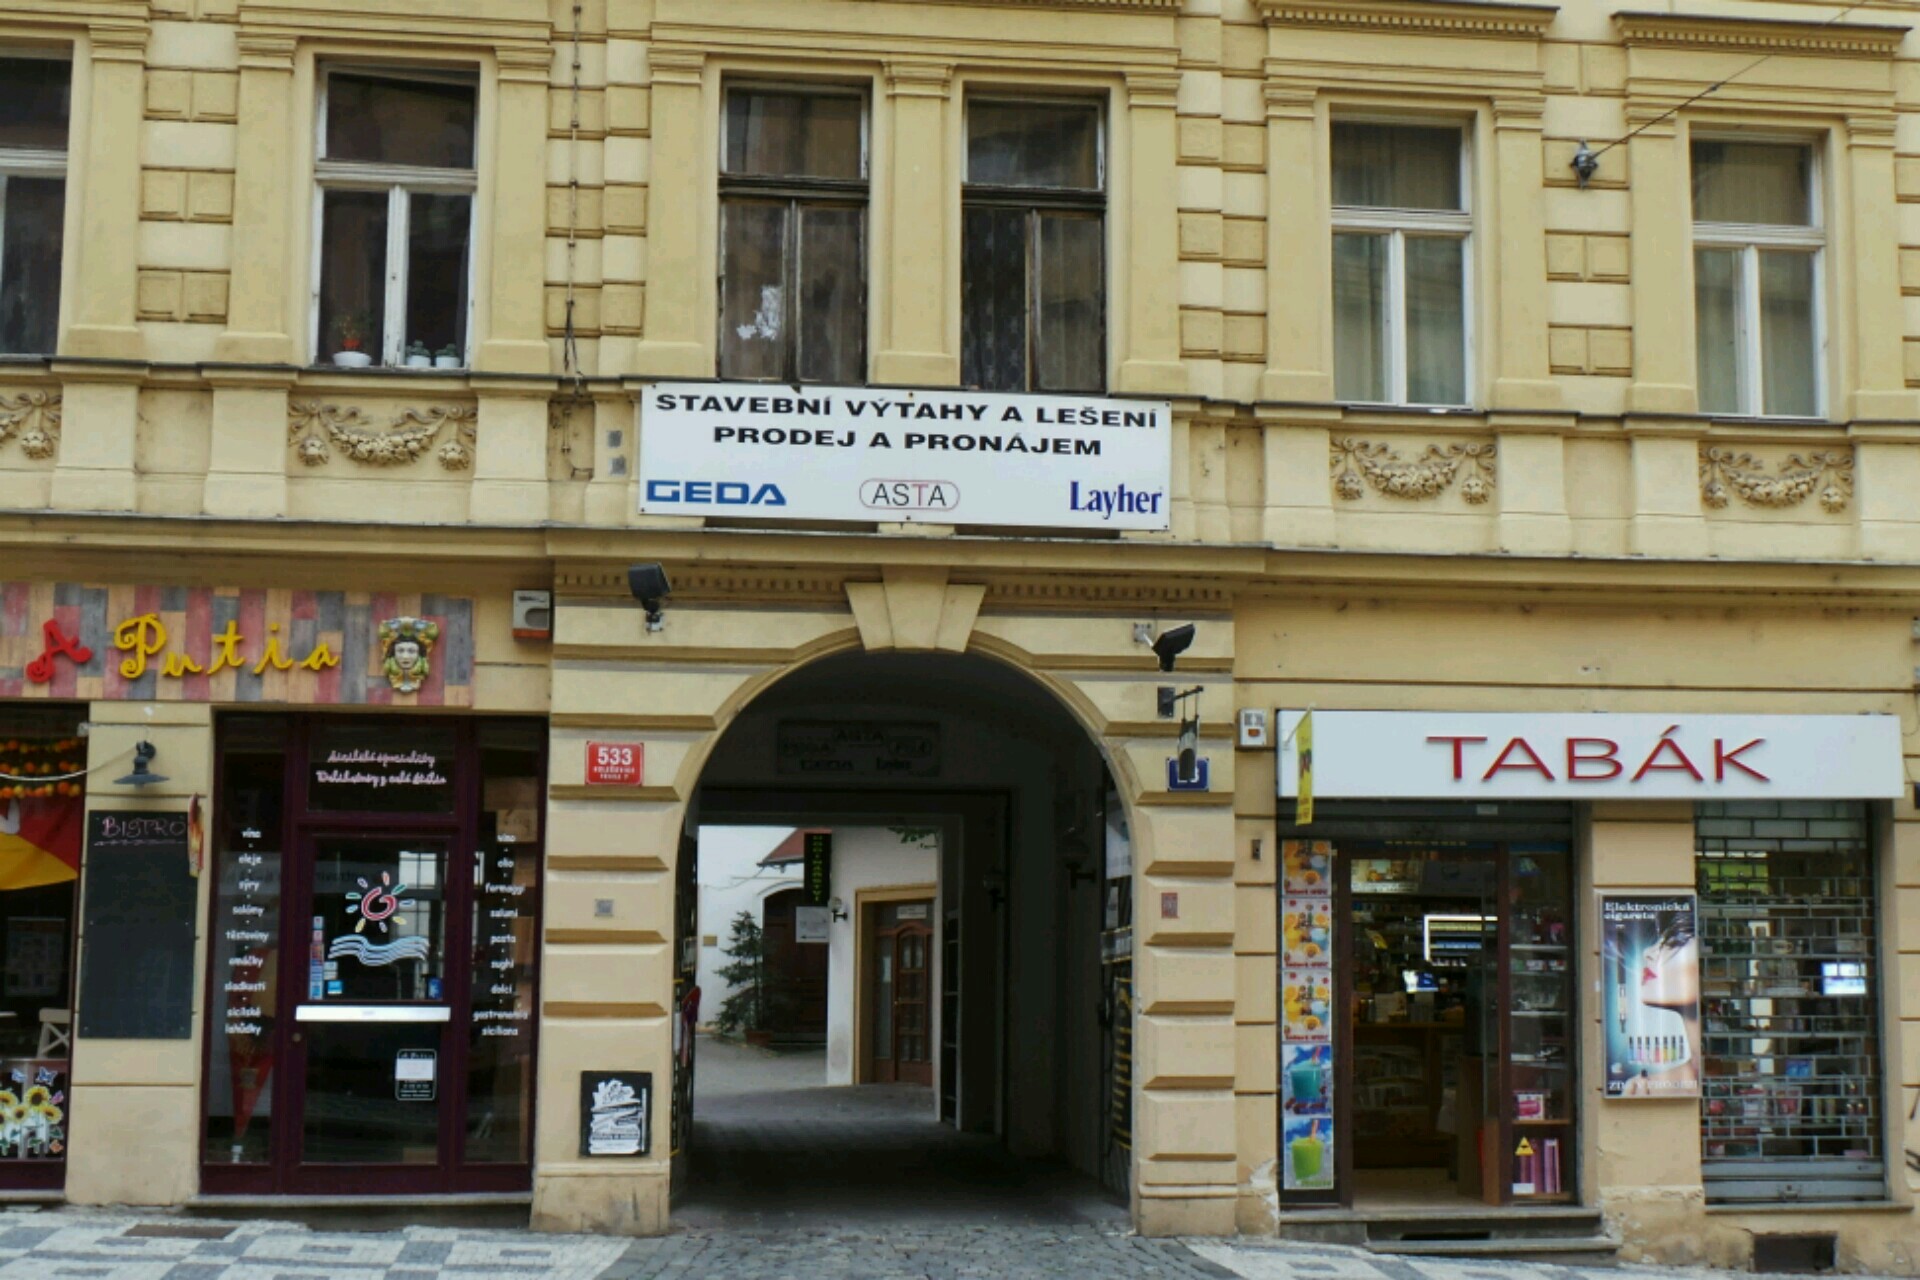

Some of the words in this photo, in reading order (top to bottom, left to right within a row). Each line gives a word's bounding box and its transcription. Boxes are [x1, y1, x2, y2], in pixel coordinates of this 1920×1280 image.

[656, 393, 832, 416] STAVEBNÍ
[845, 398, 988, 421] VÝTAHY
[1001, 406, 1023, 422] A
[1036, 406, 1157, 428] LEŠENÍ
[713, 426, 856, 447] PRODEJ
[869, 432, 892, 448] A
[904, 432, 1101, 456] PRONÁJEM
[647, 480, 787, 506] GEDA
[872, 482, 946, 507] ASTA
[1070, 480, 1164, 519] Layher
[26, 617, 93, 684] A
[113, 612, 340, 680] Putia
[598, 746, 632, 766] 533
[1426, 723, 1771, 783] TABÁK
[102, 816, 187, 838] BISTRO
[1603, 911, 1656, 921] cigareta
[1604, 902, 1691, 912] Elektronická
